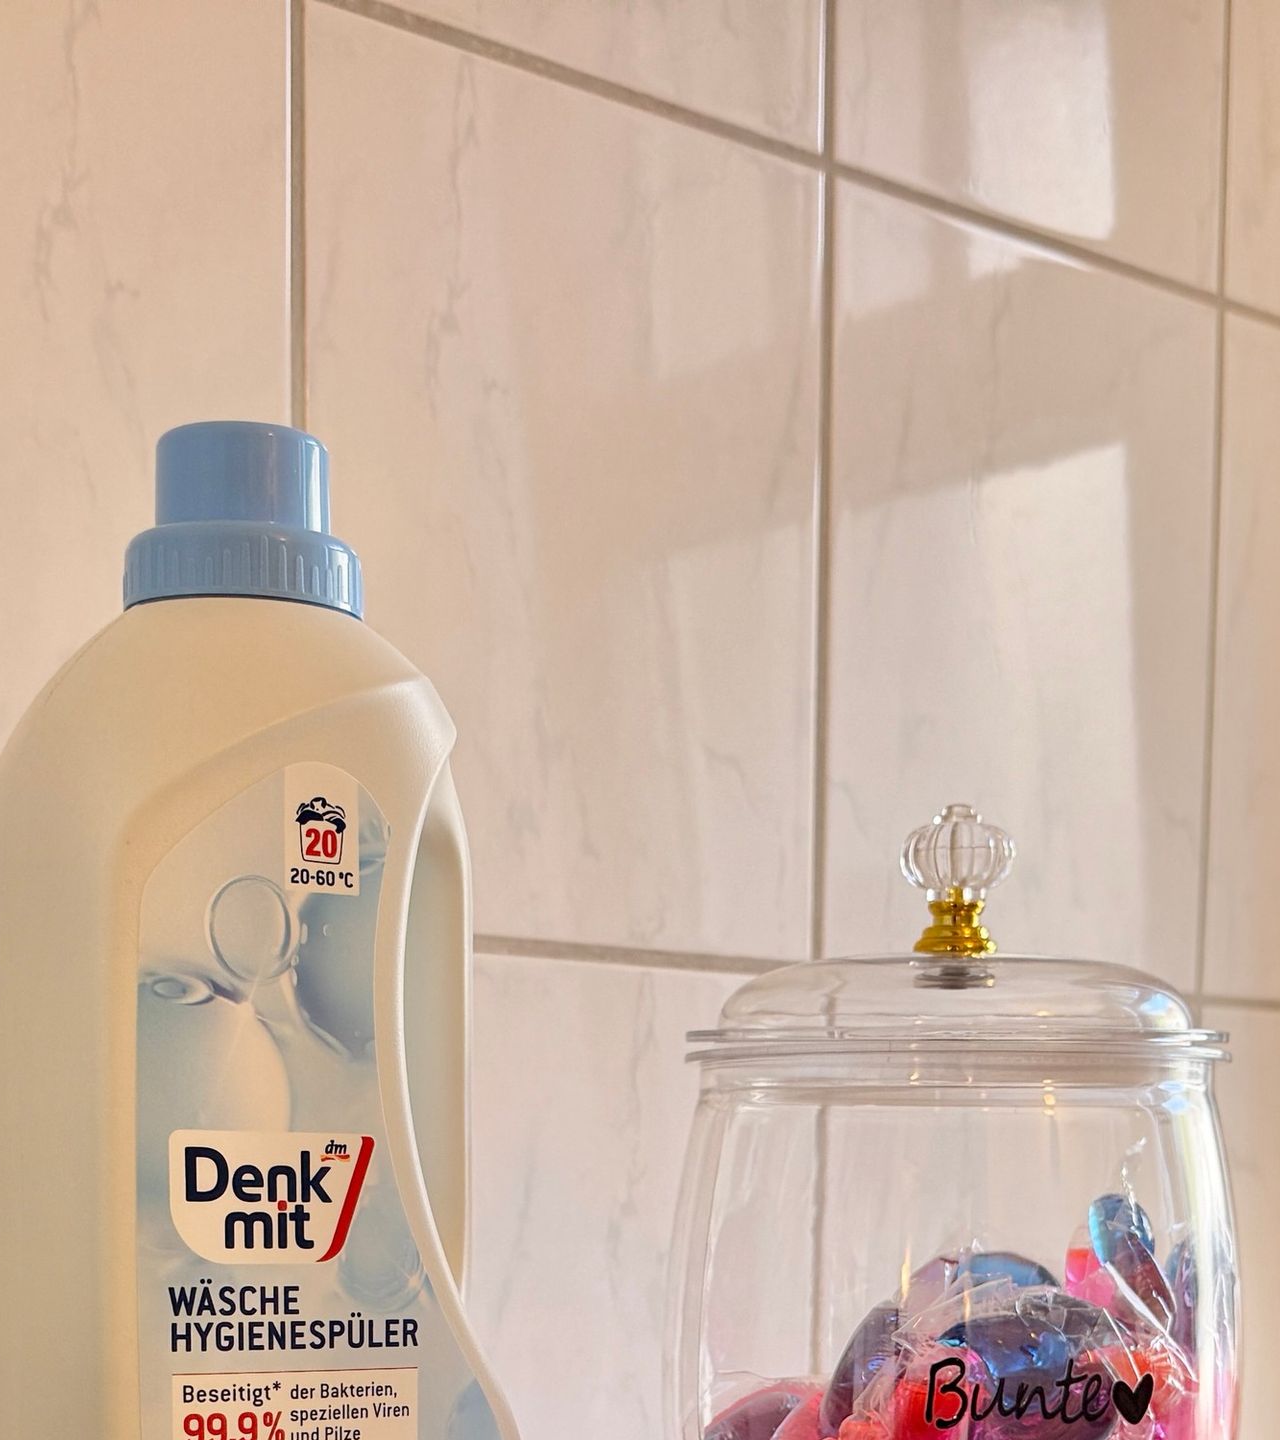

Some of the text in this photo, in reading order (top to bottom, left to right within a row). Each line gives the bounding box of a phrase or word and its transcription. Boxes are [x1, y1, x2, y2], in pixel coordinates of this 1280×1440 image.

[305, 828, 338, 858] 20
[290, 868, 335, 888] 20-60
[325, 1139, 348, 1155] dm
[184, 1146, 333, 1204] Denk
[224, 1200, 315, 1250] mit
[168, 1279, 301, 1317] WÄSCHE
[170, 1312, 419, 1352] HYGIENESPÜLER
[290, 1381, 398, 1400] der Bakterien,
[925, 1357, 1109, 1429] Bunte
[290, 1402, 410, 1425] speziellen Viren
